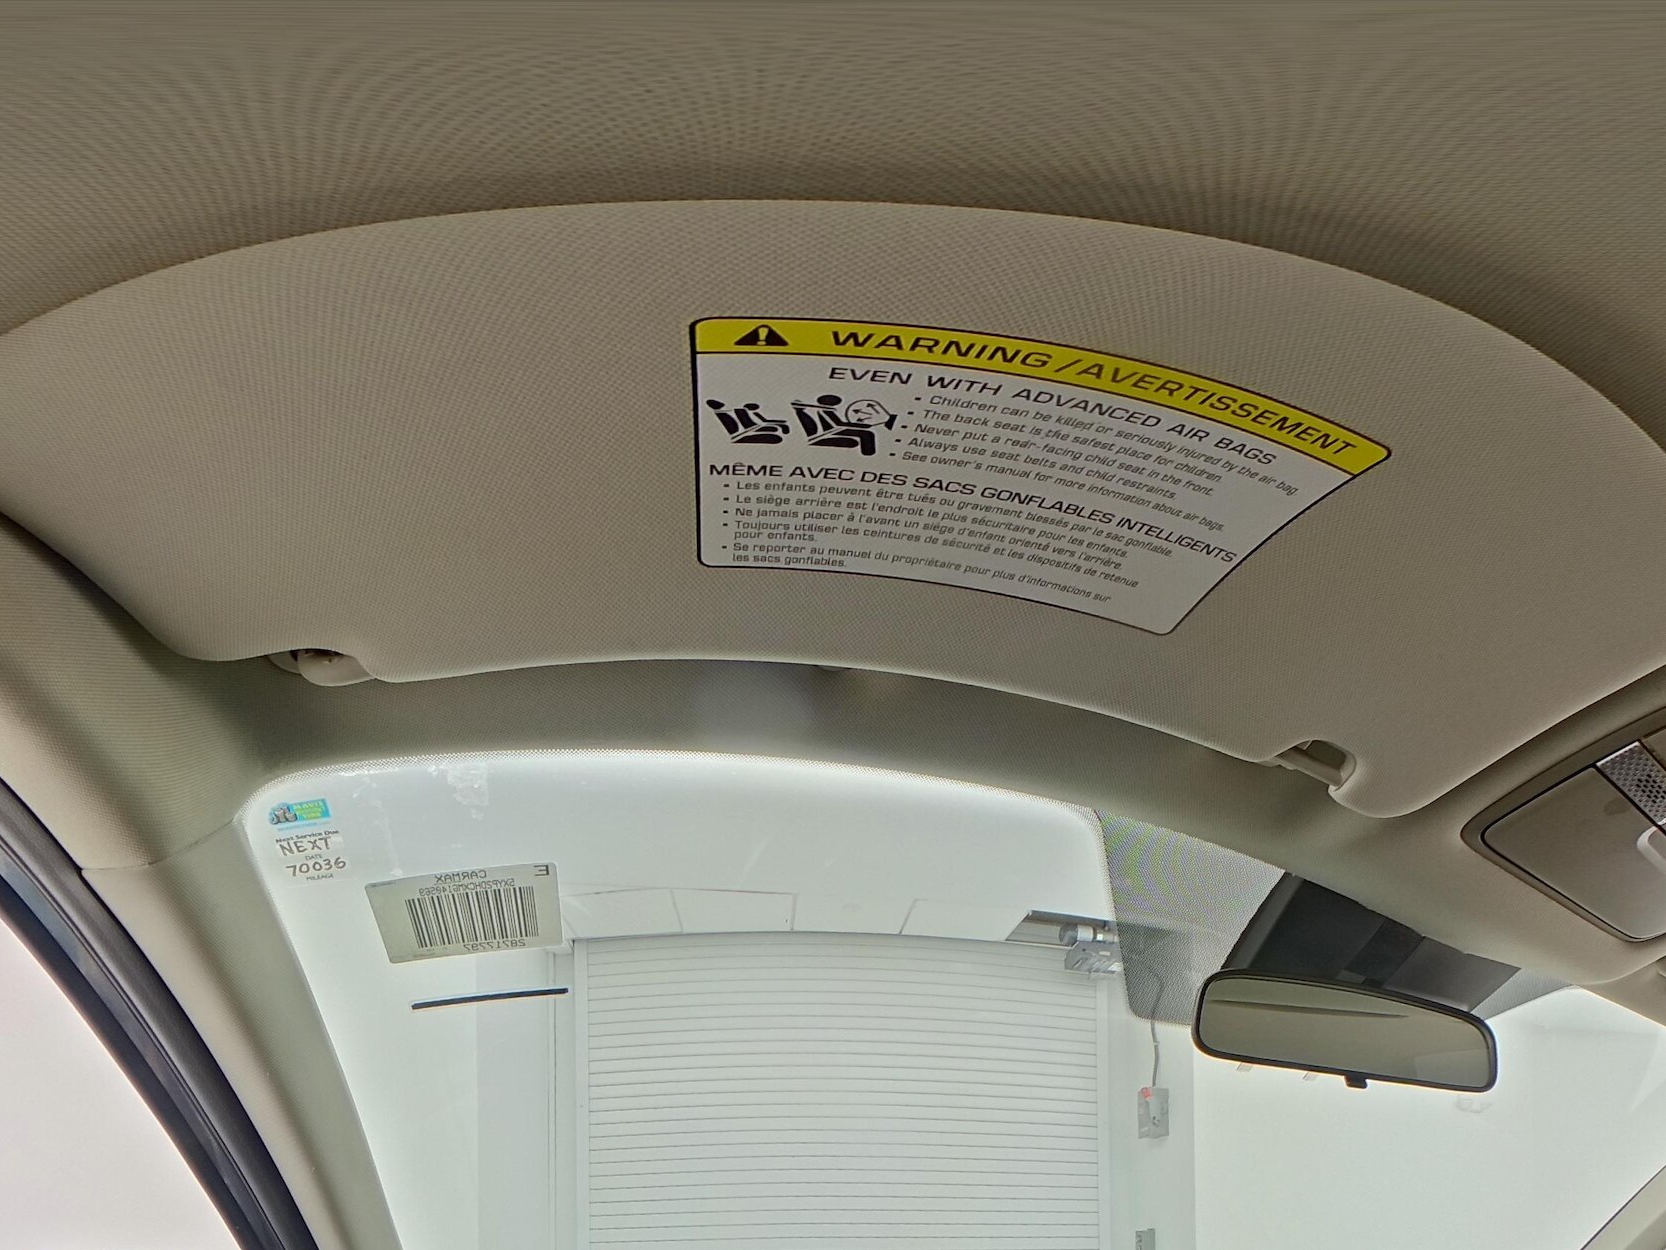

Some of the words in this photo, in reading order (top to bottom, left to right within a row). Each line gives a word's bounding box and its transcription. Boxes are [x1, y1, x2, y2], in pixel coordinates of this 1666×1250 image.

[829, 367, 912, 385] EVEN
[927, 375, 1003, 396] WITH
[1012, 388, 1162, 428] ADVANCED
[1167, 423, 1210, 443] AIR
[1214, 437, 1277, 466] BAGS
[923, 409, 950, 421] The
[954, 413, 989, 427] back
[993, 420, 1027, 433] seat
[1029, 426, 1043, 436] is
[1045, 429, 1070, 442] the
[1071, 434, 1114, 451] safest
[1115, 445, 1153, 461] place
[1153, 455, 1174, 467] for
[929, 395, 998, 413] Children
[1001, 406, 1030, 418] can
[1033, 411, 1053, 422] be
[1055, 415, 1095, 431] killed
[1095, 425, 1113, 434] or
[1115, 430, 1178, 451] seriously
[1177, 444, 1222, 466] injured
[1221, 459, 1237, 473] by
[1237, 466, 1257, 479] the
[1258, 474, 1276, 485] air
[908, 437, 959, 453] Always
[962, 446, 986, 455] use
[990, 449, 1020, 462] seat
[1023, 456, 1058, 469] belts
[1059, 463, 1084, 475] and
[1085, 468, 1117, 482] child
[914, 423, 960, 437] Never
[961, 431, 989, 442] put
[991, 435, 1001, 444] a
[1004, 438, 1083, 461] rear-facing
[1084, 454, 1117, 467] child
[1117, 462, 1147, 475] seat
[1148, 469, 1160, 479] in
[1161, 473, 1183, 486] the
[709, 461, 783, 477] MÊME
[789, 466, 855, 481] AVEC
[860, 471, 908, 486] DES
[913, 477, 977, 496] SACS
[980, 487, 1116, 524] GONFLABLES
[1116, 516, 1238, 563] INTELLIGENTS
[736, 481, 760, 490] Les
[764, 482, 815, 493] enfants
[819, 485, 871, 497] peuvent
[876, 488, 904, 500] être
[907, 490, 935, 504] tués
[939, 497, 955, 507] ou
[957, 499, 1022, 520] gravement
[1025, 511, 1070, 528] blessés
[1070, 523, 1092, 534] par
[1092, 527, 1104, 537] le
[1104, 531, 1124, 543] sac
[901, 451, 928, 462] See
[985, 464, 1033, 480] manual
[1033, 471, 1054, 483] for
[1054, 477, 1086, 490] more
[1087, 482, 1152, 508] information
[1151, 501, 1184, 517] about
[1183, 510, 1200, 522] air
[736, 495, 752, 504] Le
[756, 495, 790, 507] siège
[795, 496, 842, 509] arrière
[846, 500, 868, 510] est
[928, 509, 939, 519] le
[941, 510, 967, 524] plus
[971, 517, 1036, 536] sécuritaire
[1037, 527, 1066, 543] pour
[1067, 533, 1085, 546] les
[279, 836, 331, 856] NEXT
[285, 856, 347, 877] 70036
